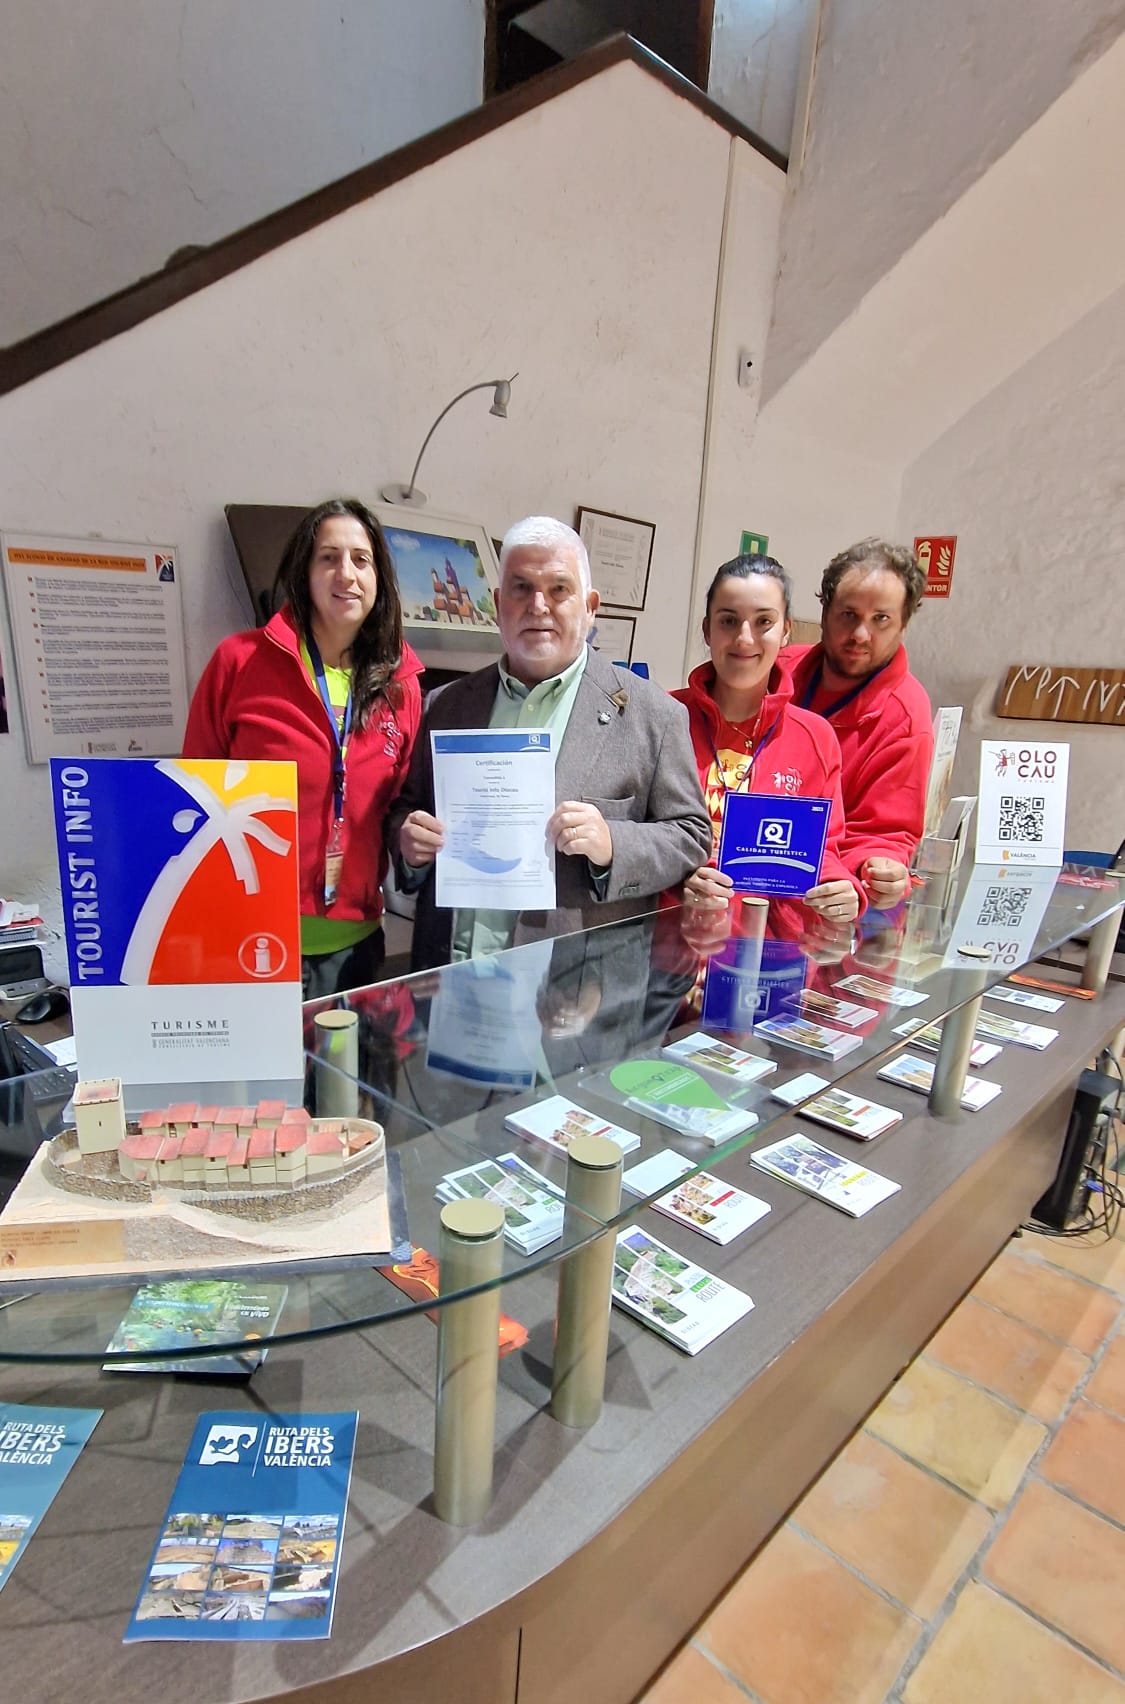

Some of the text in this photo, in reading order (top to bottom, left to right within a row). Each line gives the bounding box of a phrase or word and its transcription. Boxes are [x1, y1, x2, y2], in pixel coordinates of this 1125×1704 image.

[1018, 749, 1057, 764] OLO
[1017, 764, 1056, 778] CAU
[735, 846, 767, 855] CALIDAD
[60, 766, 104, 981] TOURIST INFO
[150, 1020, 230, 1030] TURISME
[695, 1281, 726, 1303] ROUTE
[2, 1420, 65, 1434] RUTA DELS
[269, 1426, 330, 1437] RUTA DELS
[0, 1430, 66, 1452] IBERS
[264, 1436, 336, 1455] IBERS
[263, 1452, 332, 1468] VALÈNCIA
